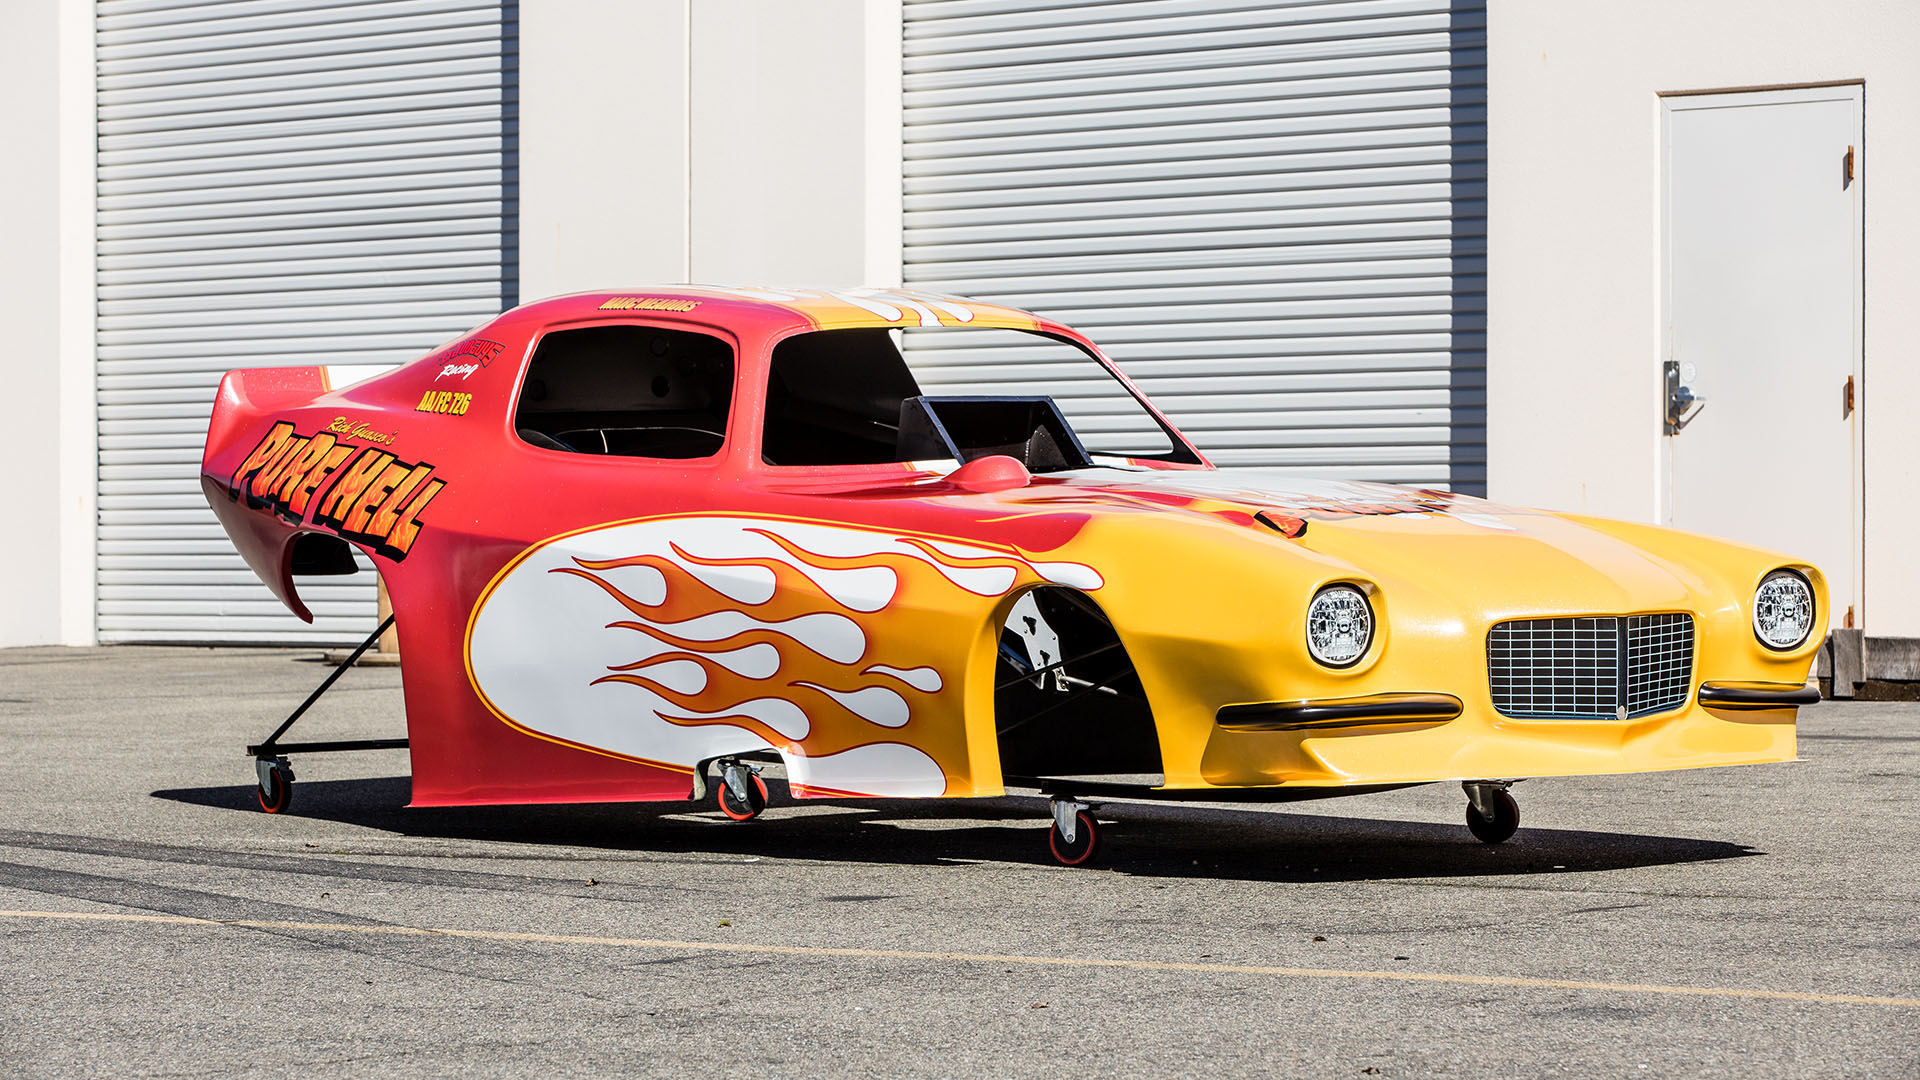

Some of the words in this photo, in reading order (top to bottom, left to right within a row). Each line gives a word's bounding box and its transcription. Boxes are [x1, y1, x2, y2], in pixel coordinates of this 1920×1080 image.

[598, 297, 645, 310] MARC
[434, 363, 479, 382] Racing
[414, 390, 453, 414] AA/FC
[446, 392, 472, 416] 726
[325, 416, 359, 434] Rich
[345, 422, 399, 446] Guasco's
[229, 420, 358, 525] PURE
[312, 446, 448, 563] HELL
